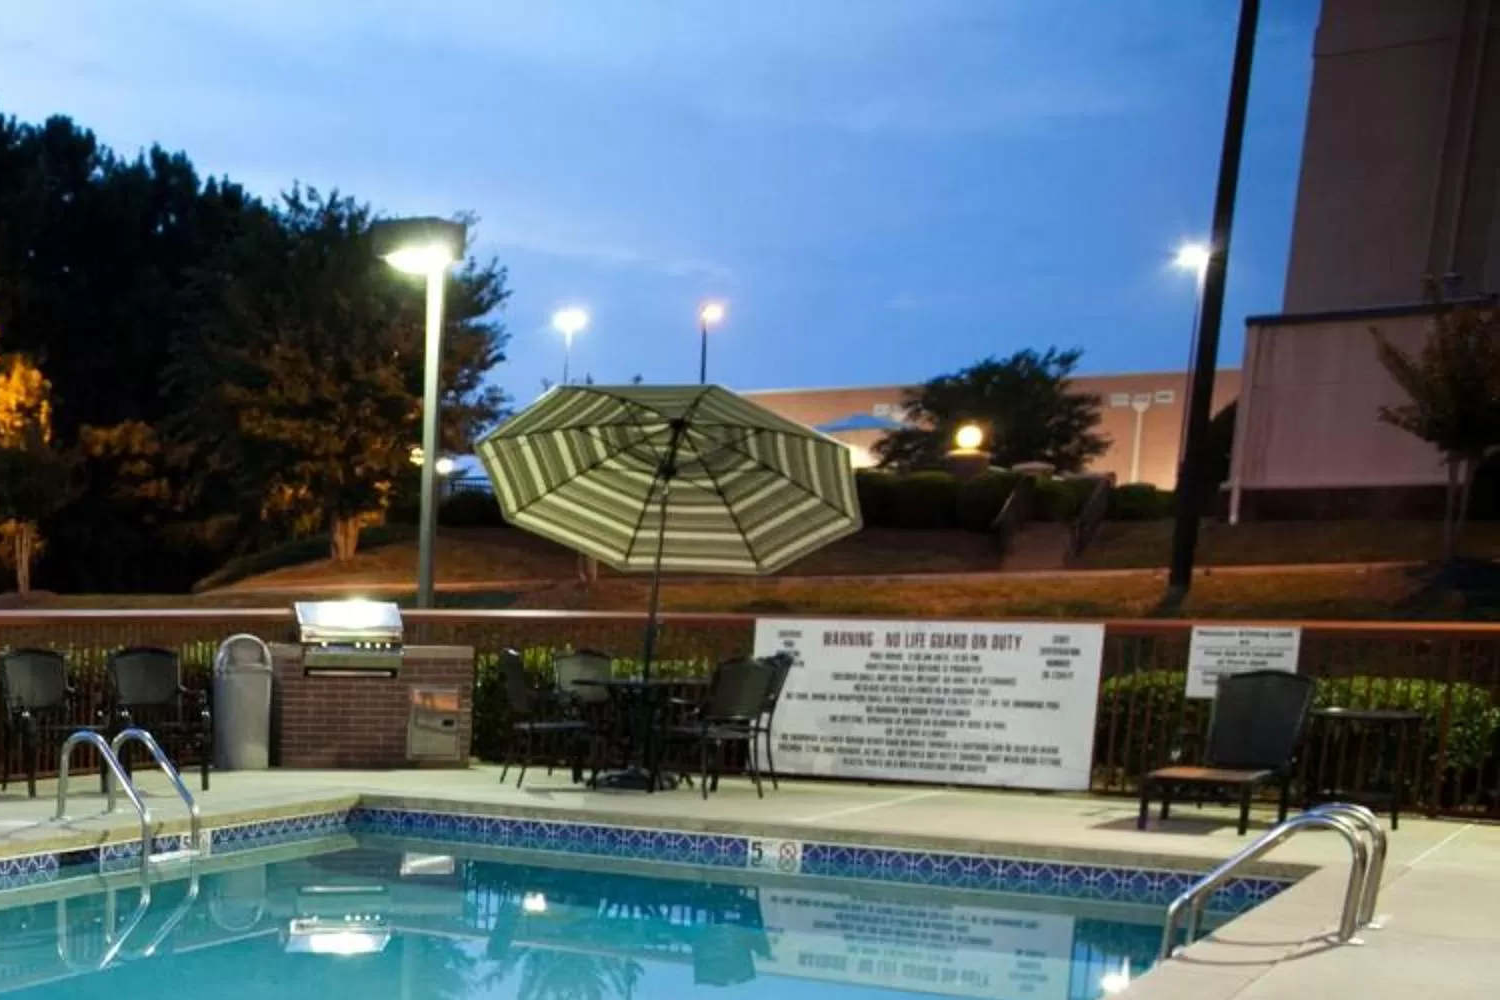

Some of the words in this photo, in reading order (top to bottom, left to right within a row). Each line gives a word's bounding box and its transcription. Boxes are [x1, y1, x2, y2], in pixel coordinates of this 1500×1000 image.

[823, 630, 874, 648] WARNING
[885, 631, 901, 649] NO
[905, 631, 925, 650] LIFE
[930, 632, 967, 650] GUARD
[971, 633, 988, 650] ON
[991, 633, 1023, 652] DUTY
[752, 842, 763, 861] 5
